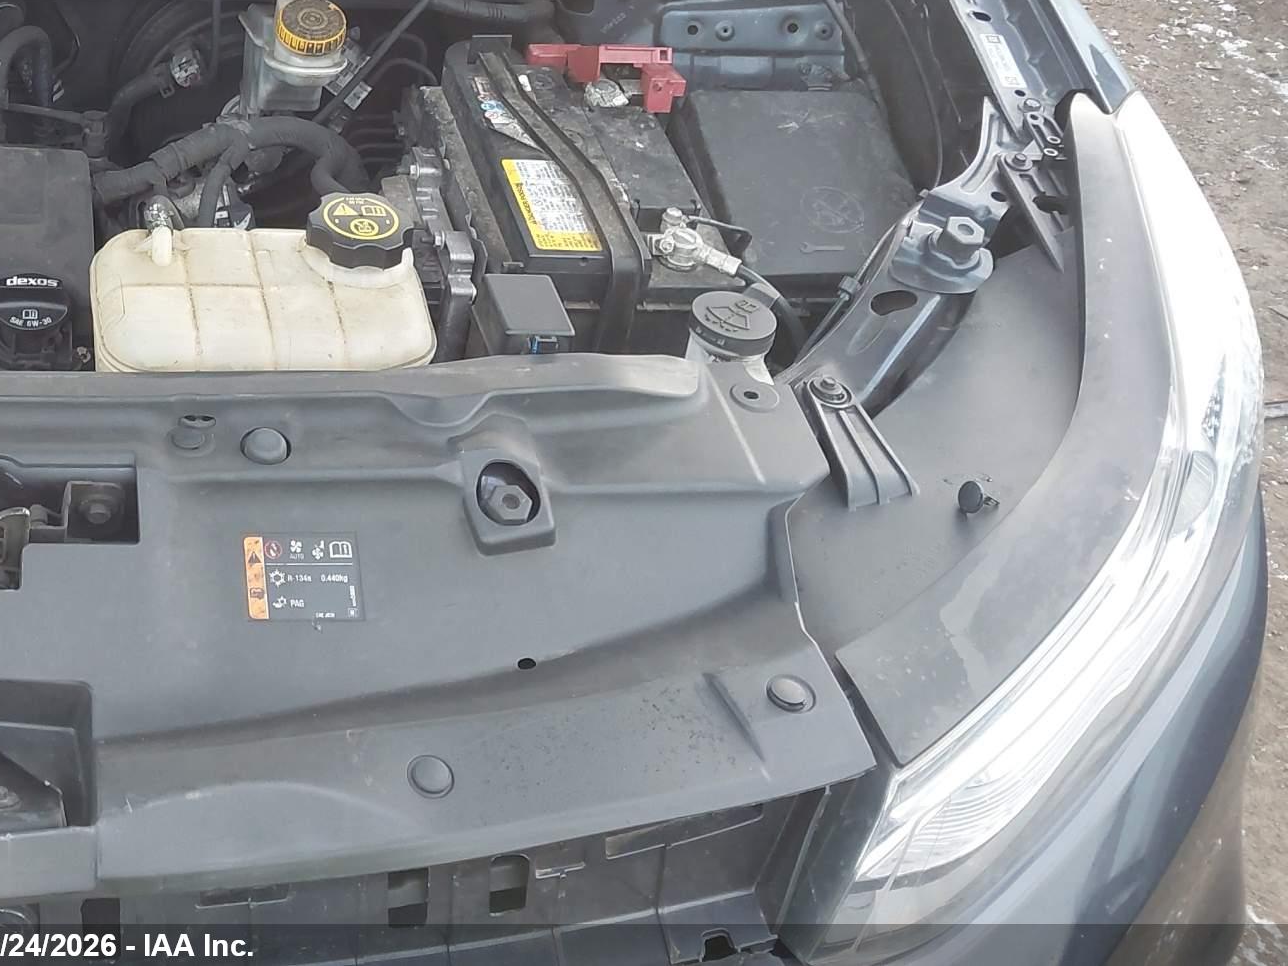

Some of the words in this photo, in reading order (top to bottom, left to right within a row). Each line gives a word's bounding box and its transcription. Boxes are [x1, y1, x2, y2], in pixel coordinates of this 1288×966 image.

[6, 275, 60, 287] dexos
[9, 316, 24, 326] SAE
[287, 574, 312, 582] R-134a
[290, 599, 305, 608] PAG
